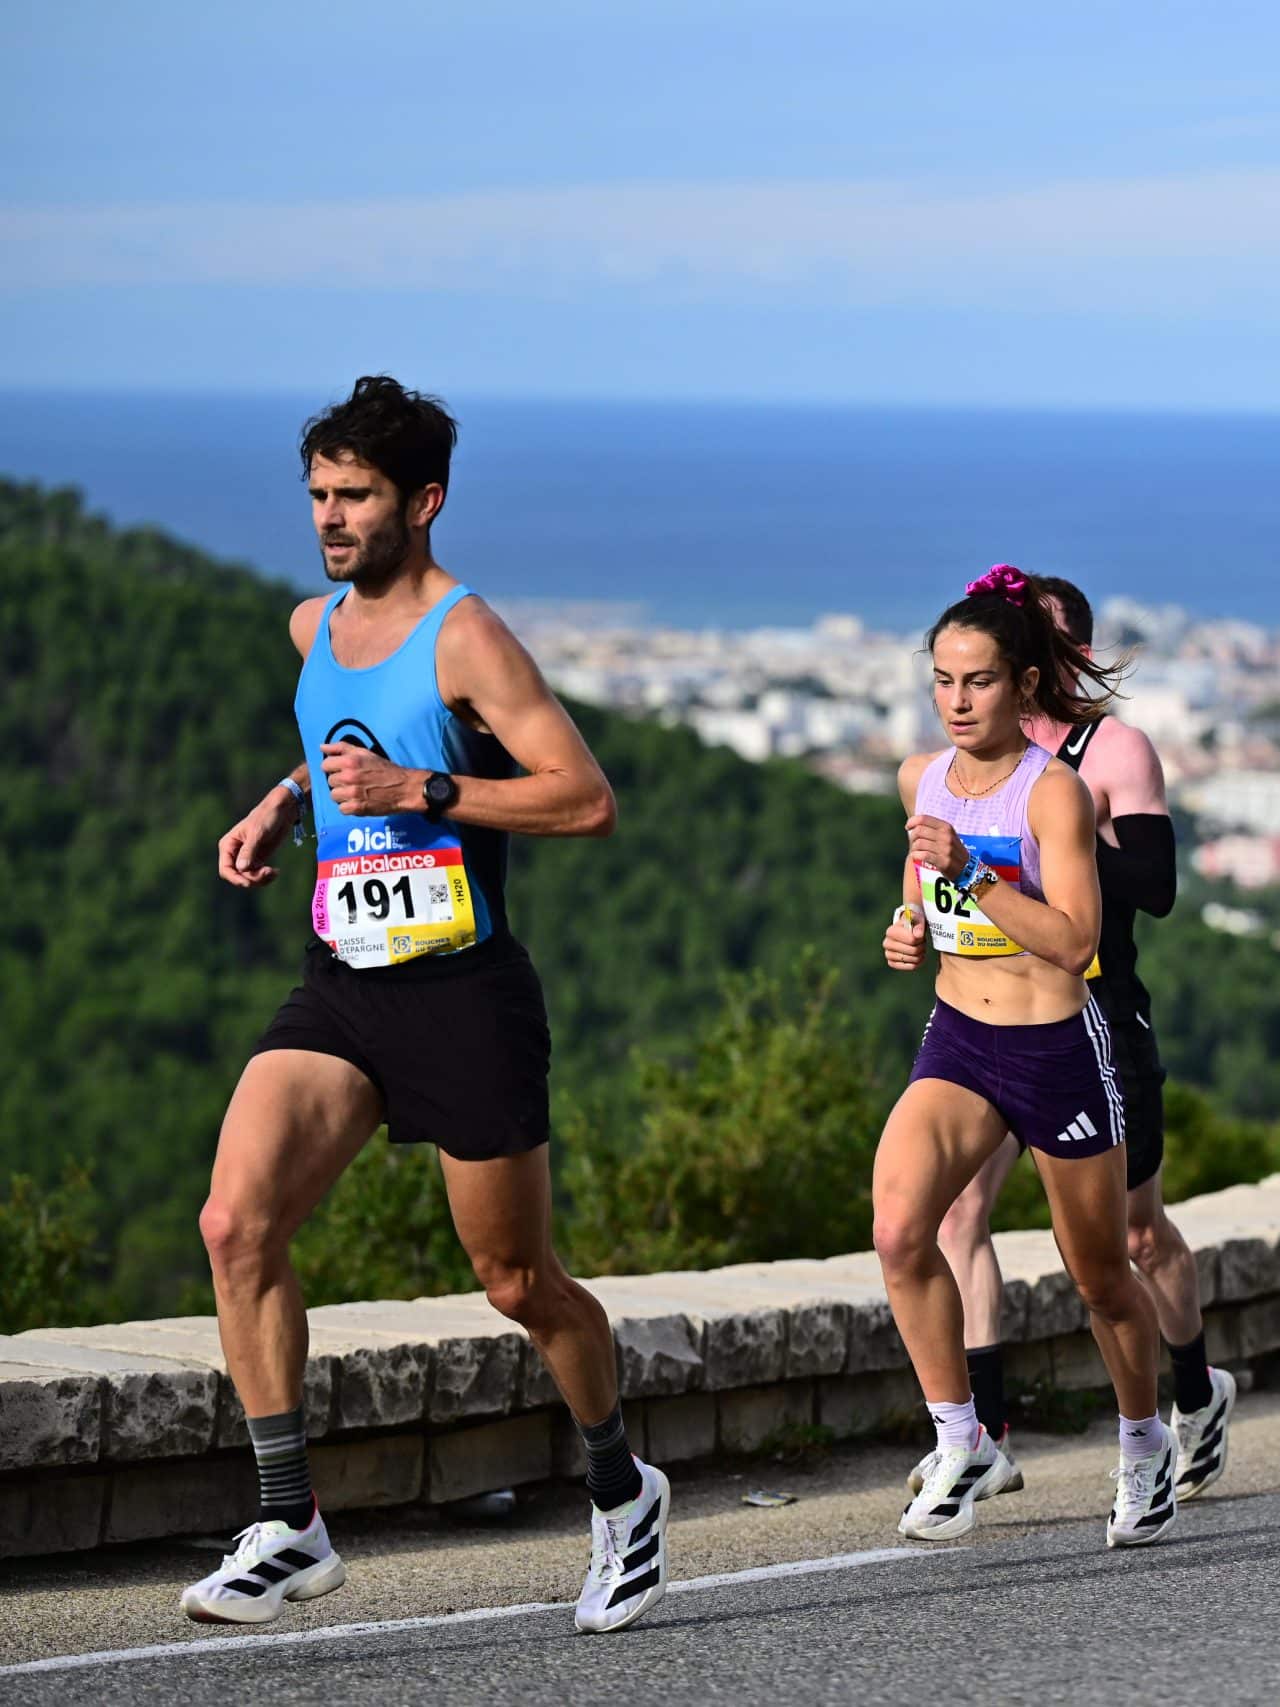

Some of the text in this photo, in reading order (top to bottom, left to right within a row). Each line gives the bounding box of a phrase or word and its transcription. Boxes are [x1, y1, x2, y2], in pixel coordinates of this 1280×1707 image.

[332, 854, 436, 876] new balance
[337, 875, 415, 924] 191
[338, 937, 366, 947] CAISSE
